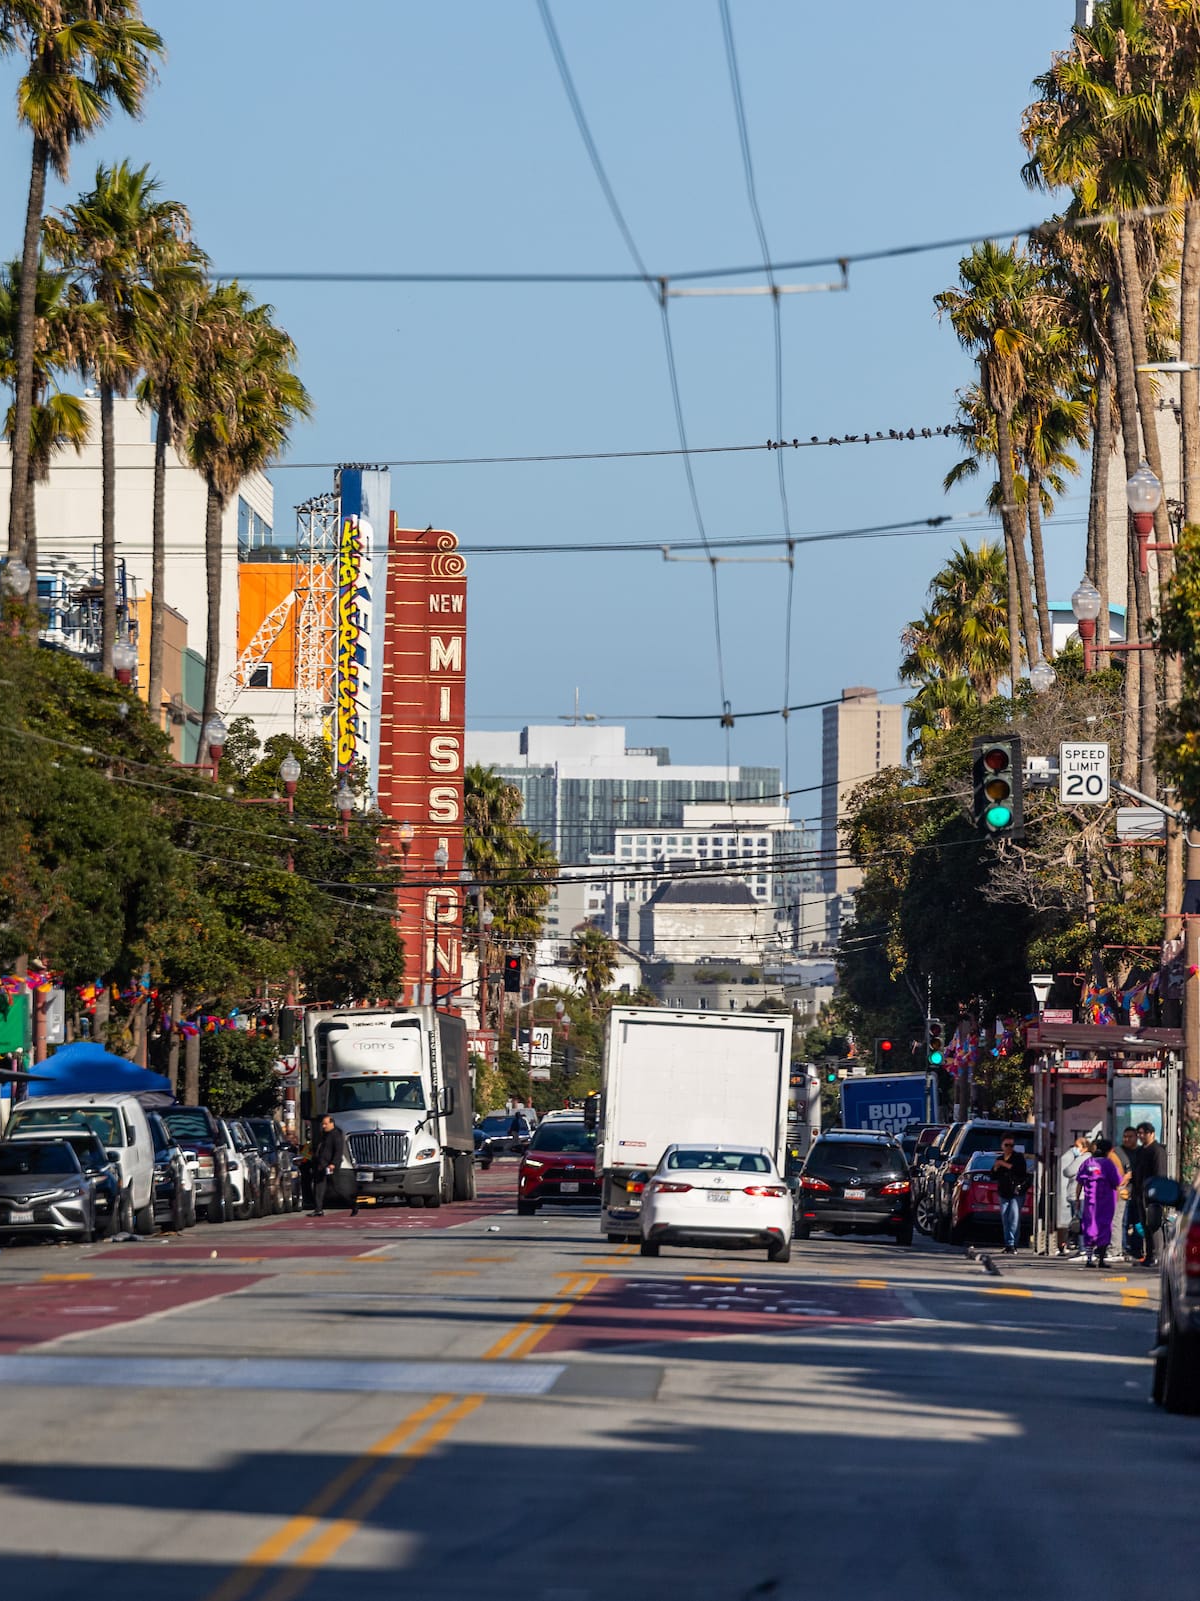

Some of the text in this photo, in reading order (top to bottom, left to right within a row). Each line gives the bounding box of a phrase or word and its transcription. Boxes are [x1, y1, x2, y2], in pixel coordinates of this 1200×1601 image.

[429, 594, 464, 613] NEW
[1065, 750, 1105, 759] SPEED
[1069, 762, 1101, 772] LIMIT
[1066, 774, 1103, 796] 20
[426, 635, 464, 974] MISSION
[868, 1103, 912, 1119] BUD
